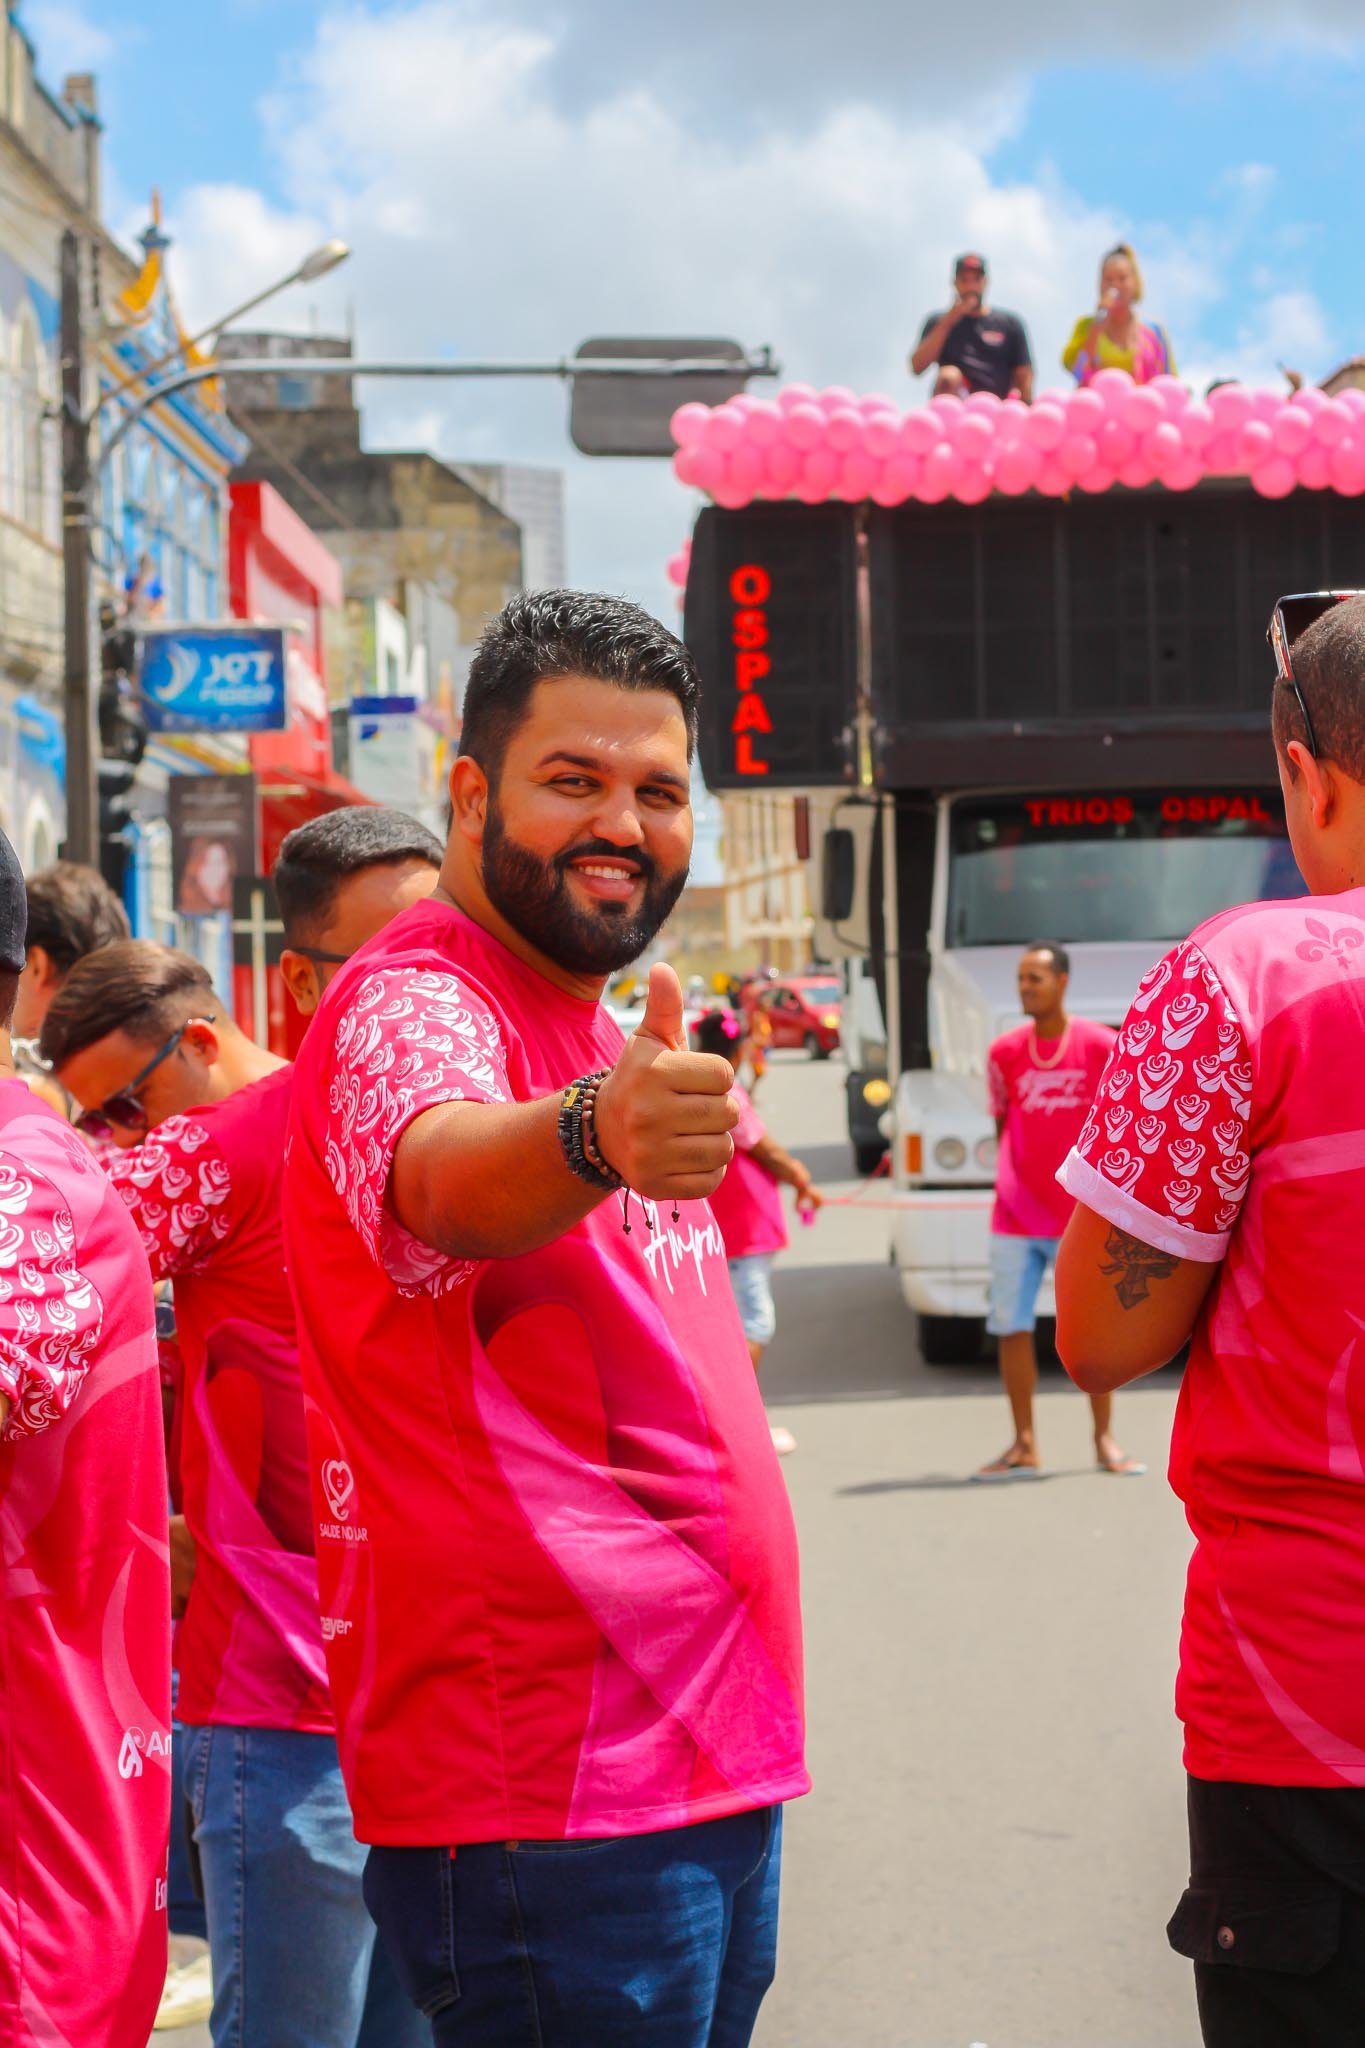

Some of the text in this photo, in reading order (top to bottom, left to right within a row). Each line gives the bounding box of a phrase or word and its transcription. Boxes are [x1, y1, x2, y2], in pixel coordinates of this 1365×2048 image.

[729, 564, 773, 776] OSPAL
[1024, 796, 1271, 827] TRIOS OSPAL
[341, 1525, 354, 1541] NO
[353, 1527, 369, 1543] LAR
